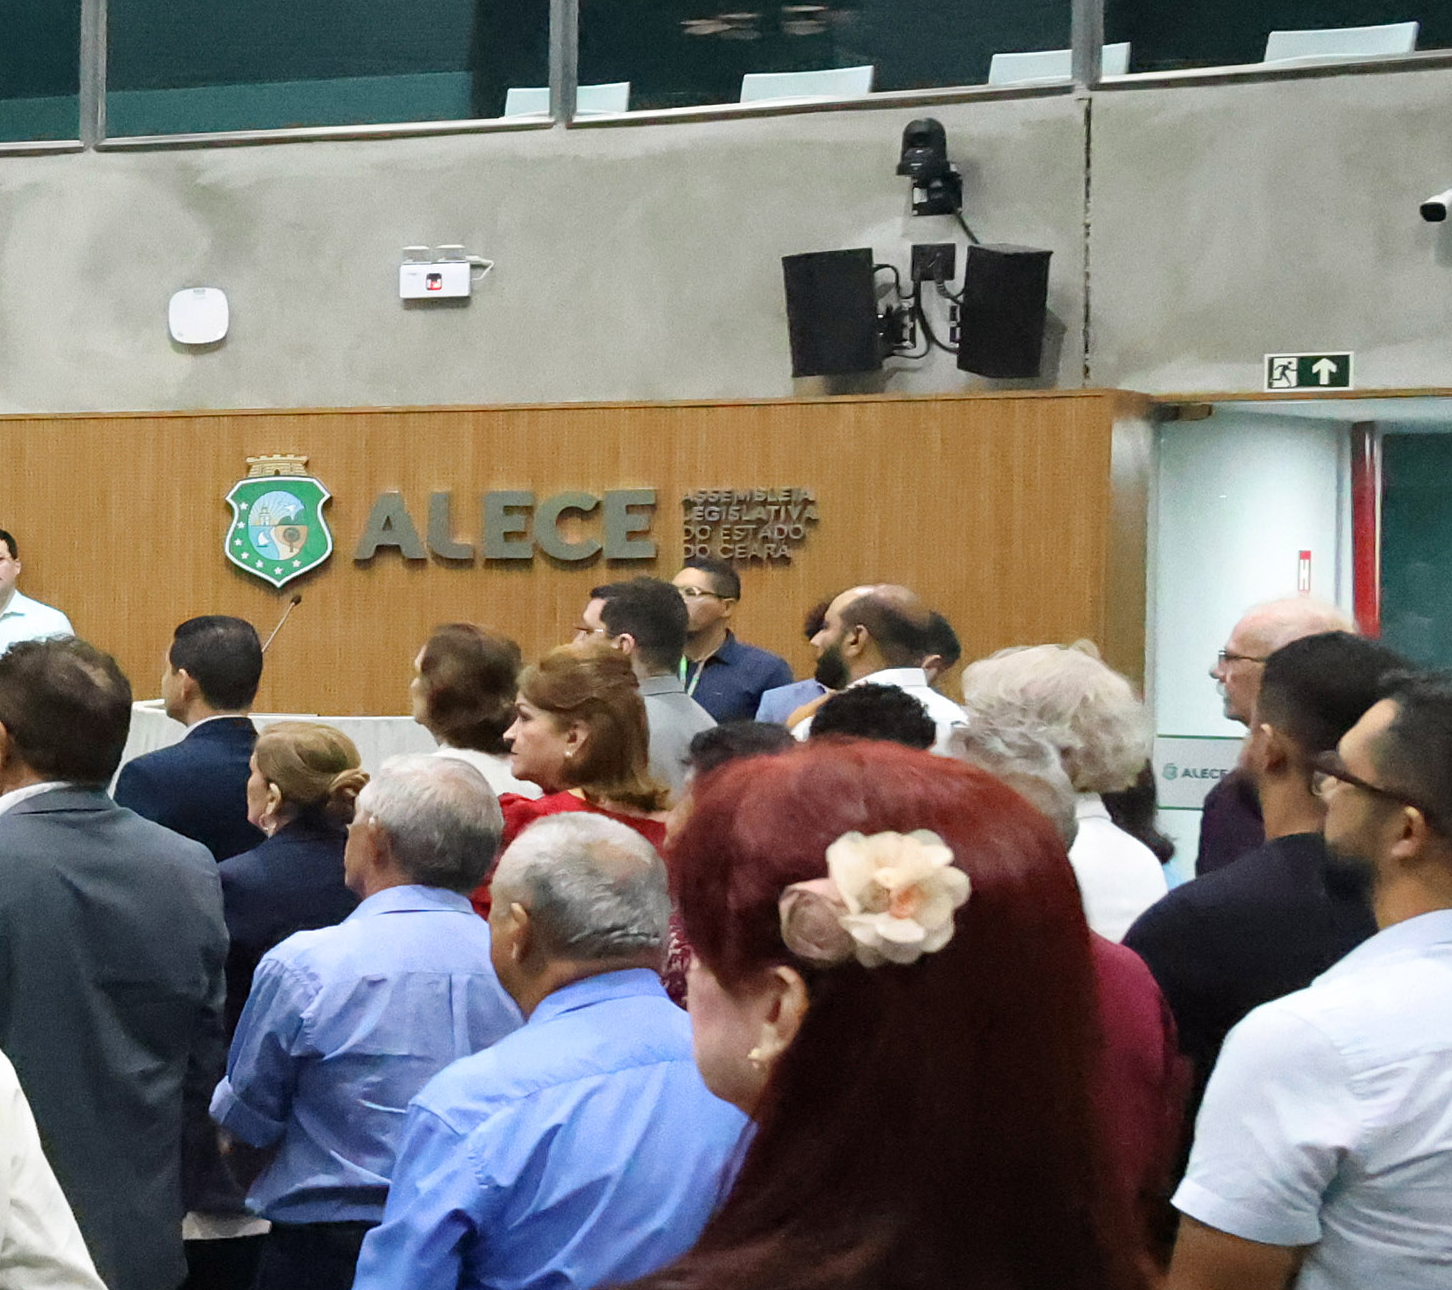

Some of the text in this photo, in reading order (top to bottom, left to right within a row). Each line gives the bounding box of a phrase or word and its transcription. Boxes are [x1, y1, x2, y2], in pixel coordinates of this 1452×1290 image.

[683, 505, 820, 522] LEGISLATIVA
[353, 489, 658, 561] ALECE
[683, 524, 806, 540] DO ESTADO
[683, 543, 711, 559] DO
